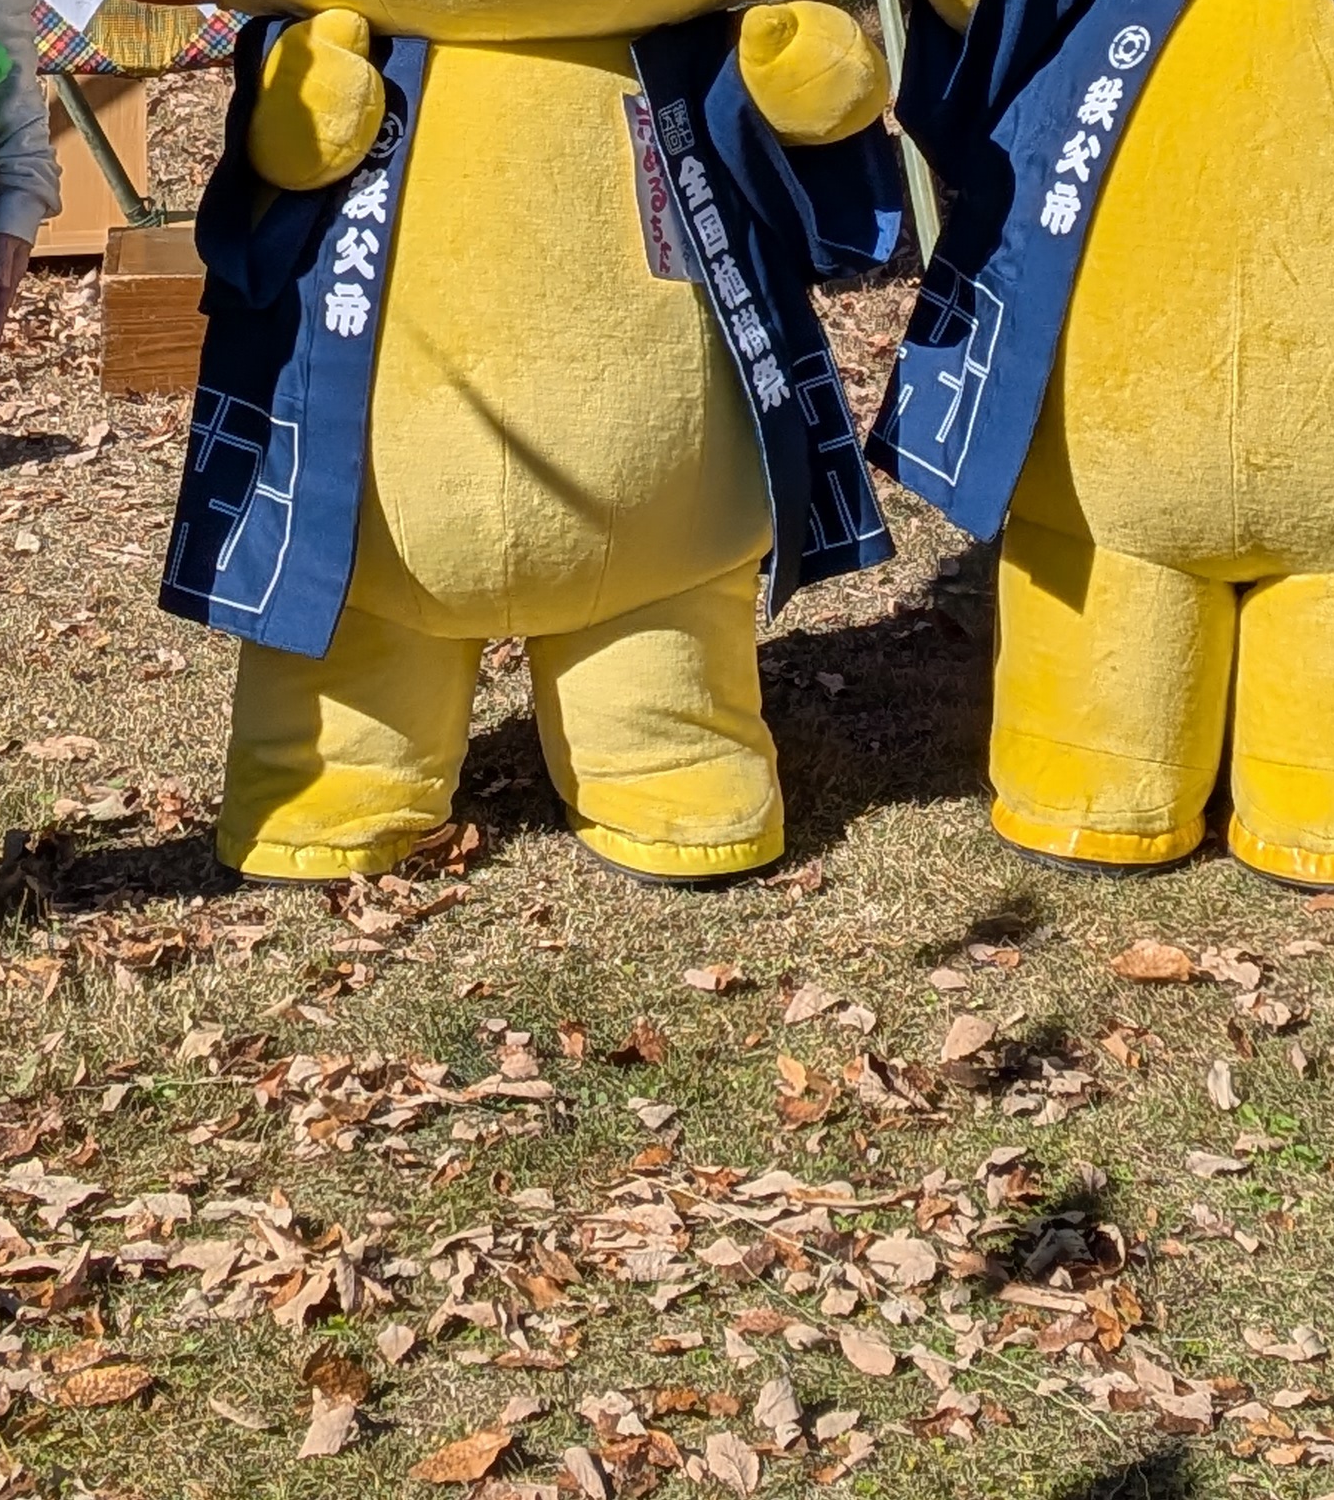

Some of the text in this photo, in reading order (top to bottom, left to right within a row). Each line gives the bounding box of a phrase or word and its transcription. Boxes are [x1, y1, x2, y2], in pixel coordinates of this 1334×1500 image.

[1040, 75, 1124, 235] 秩父市
[324, 168, 391, 338] 秩父市
[678, 156, 790, 413] 全国植樹祭
